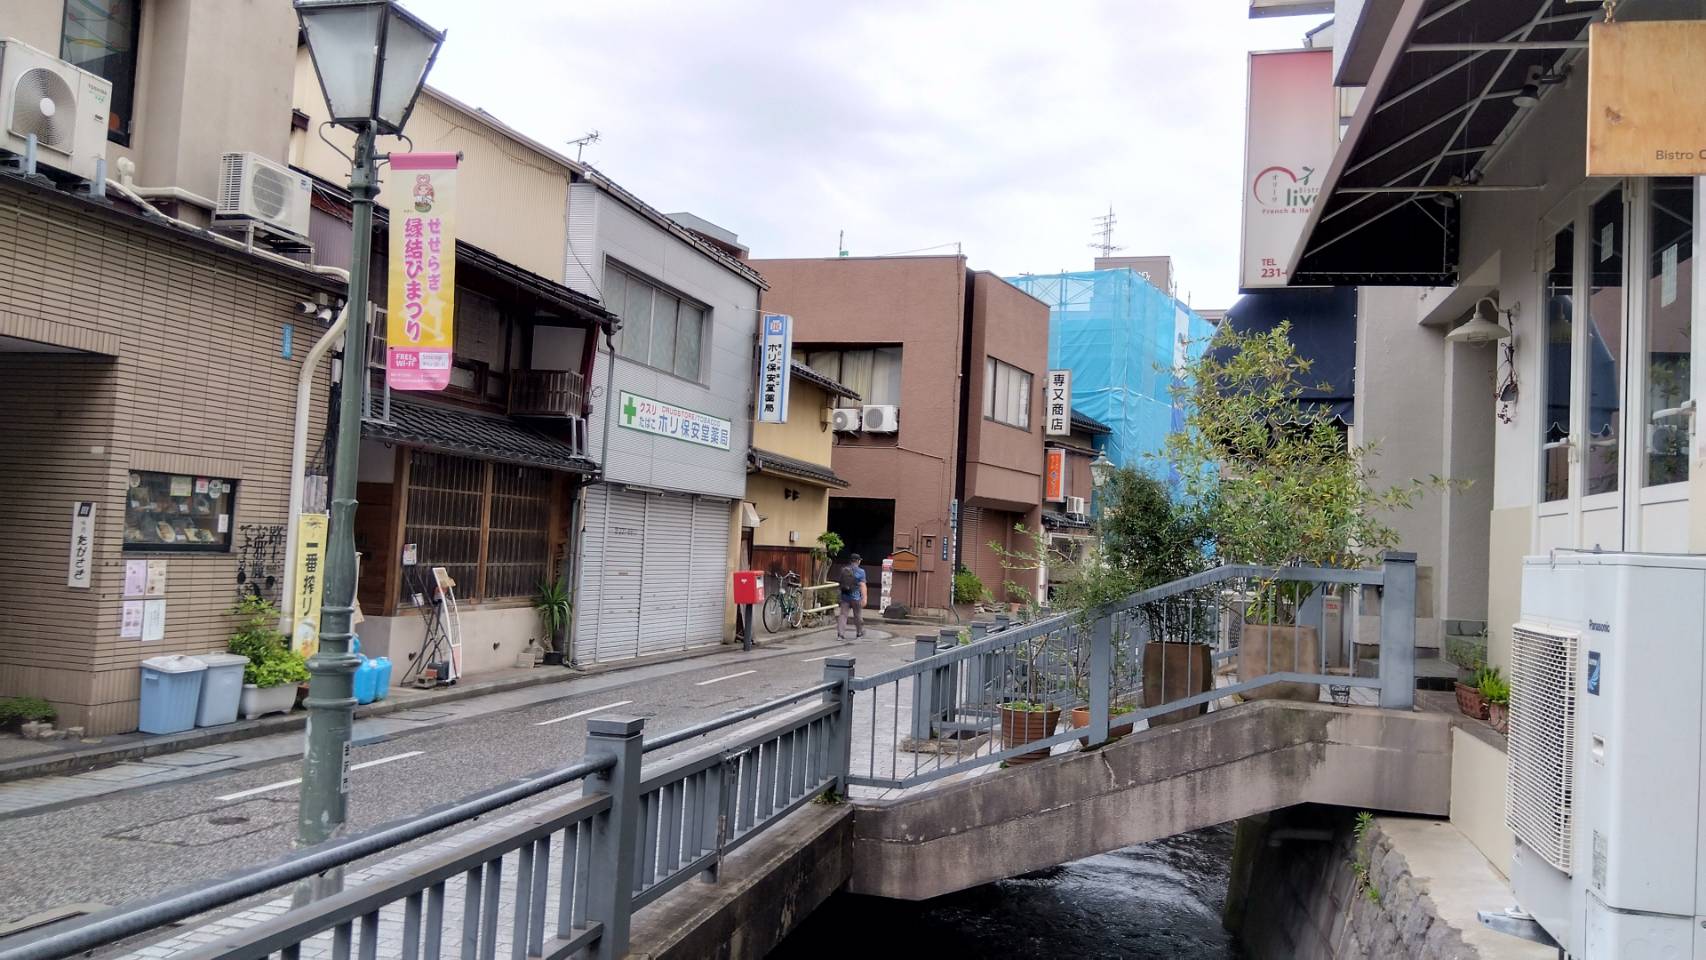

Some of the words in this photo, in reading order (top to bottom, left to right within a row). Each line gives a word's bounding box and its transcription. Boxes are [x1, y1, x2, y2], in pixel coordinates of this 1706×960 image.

[1656, 150, 1694, 160] Bistro
[405, 218, 423, 341] 縁結びまつり
[1261, 258, 1277, 267] TEL
[764, 344, 779, 413] ホリ保安堂薬局
[640, 402, 657, 416] クスリ
[1051, 374, 1065, 431] 専又商店
[658, 414, 729, 446] ホリ保安堂薬局
[303, 542, 319, 617] 一番搾り
